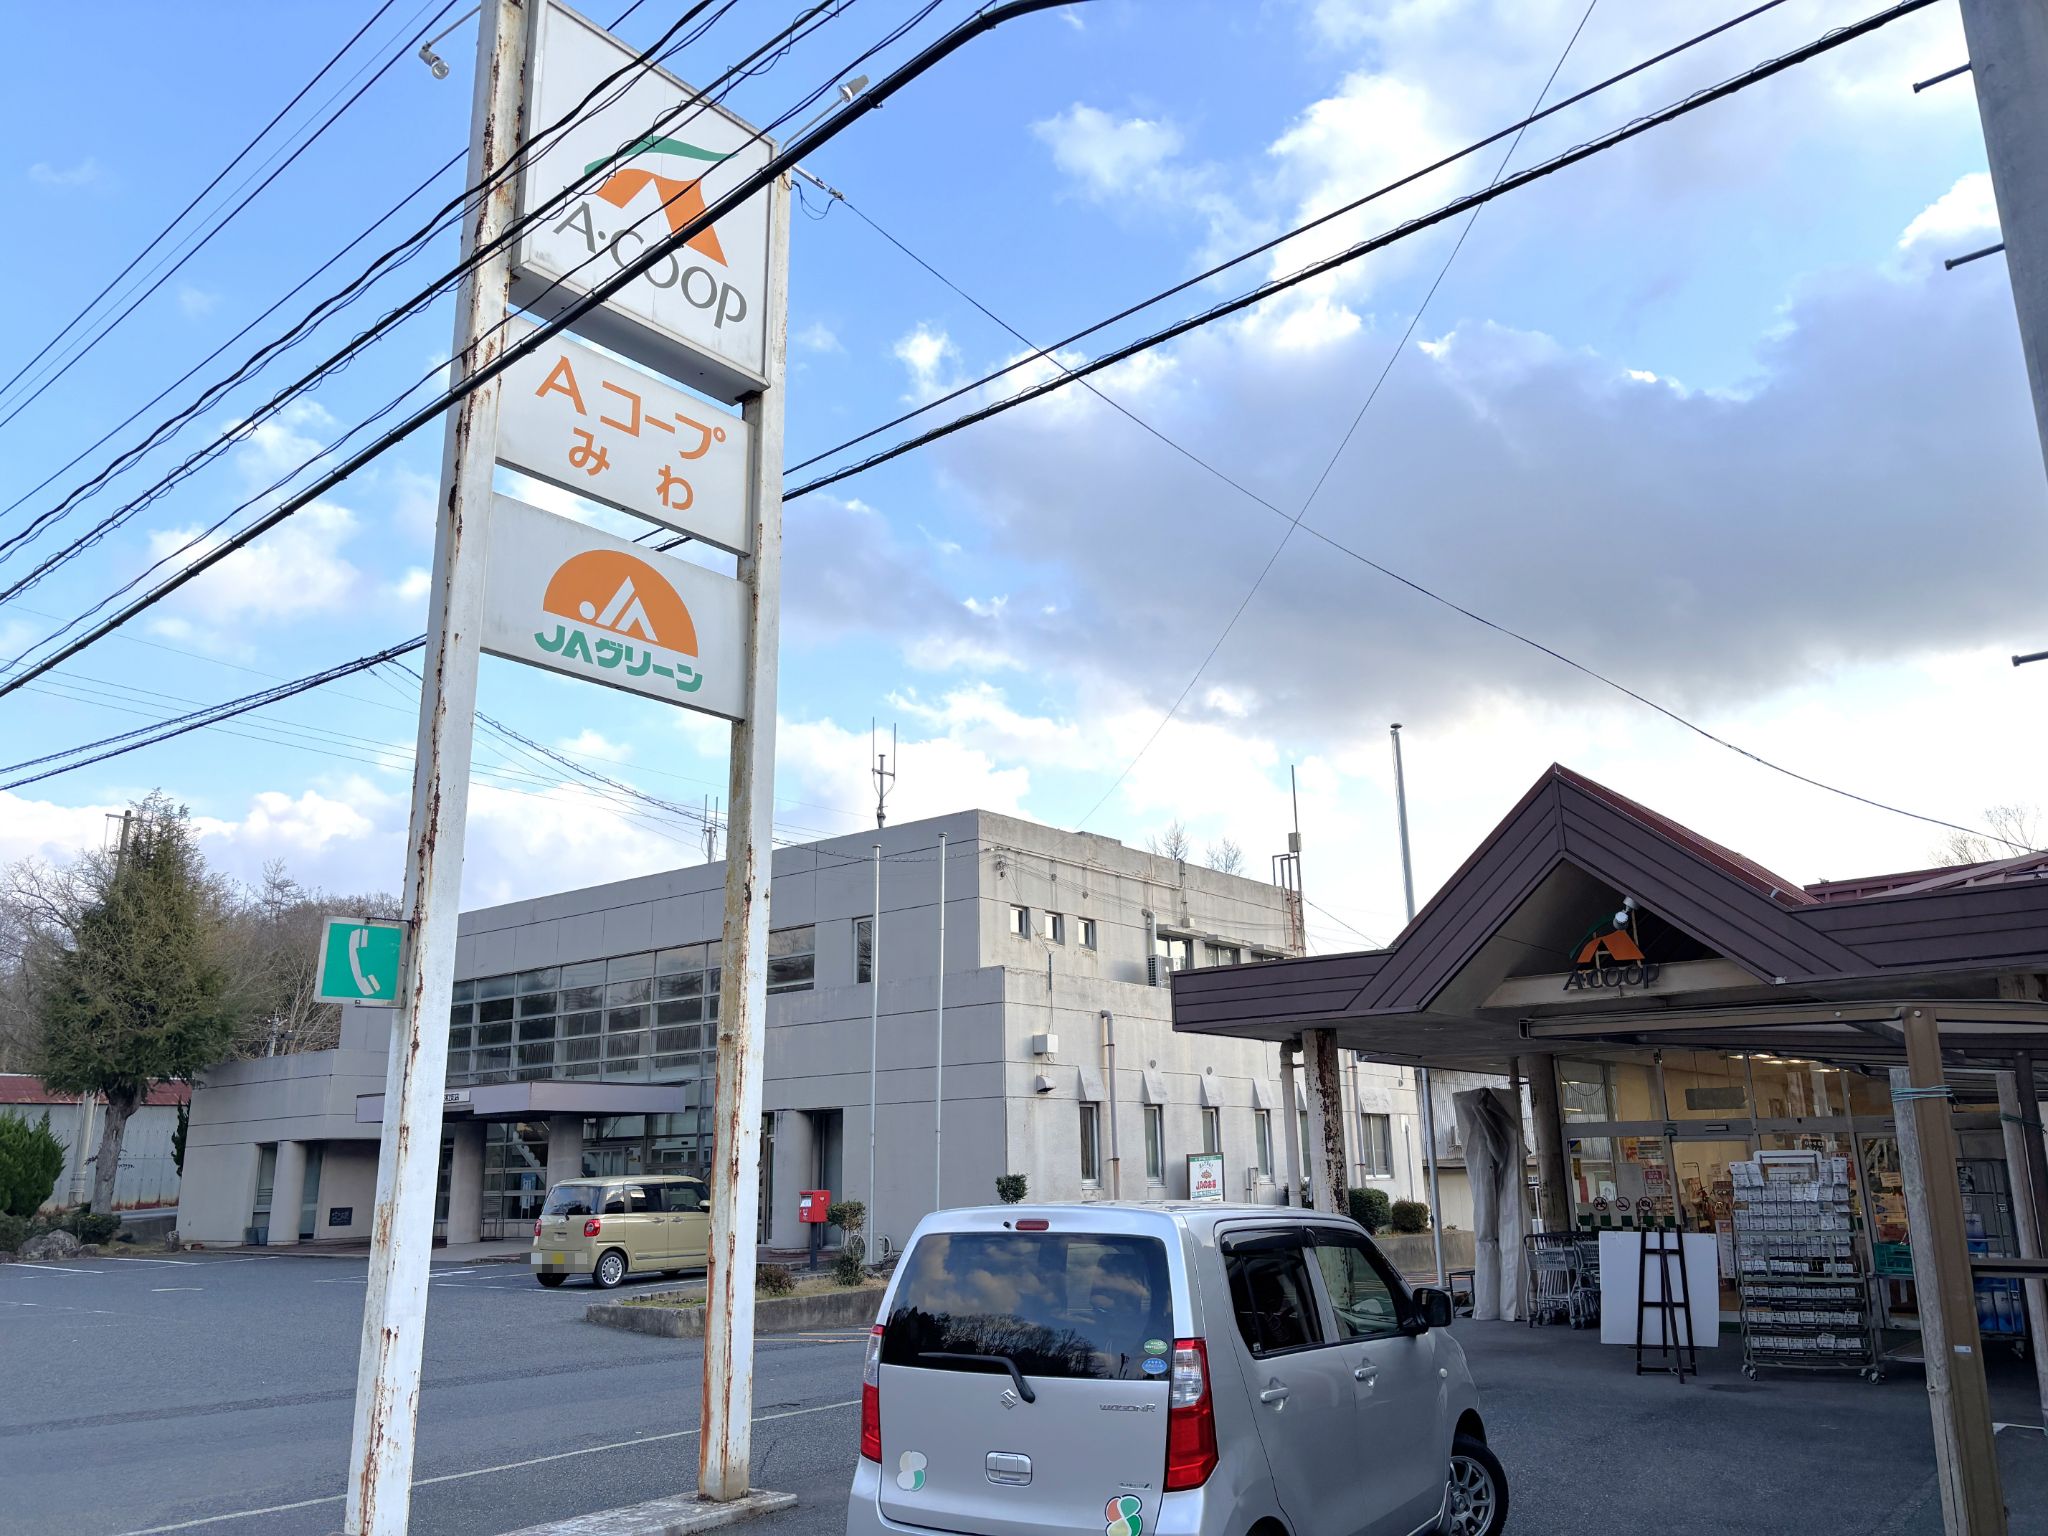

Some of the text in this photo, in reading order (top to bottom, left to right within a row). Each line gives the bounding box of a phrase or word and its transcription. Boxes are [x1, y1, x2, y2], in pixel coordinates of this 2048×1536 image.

[535, 354, 727, 460] Aコープ
[534, 624, 704, 693] JAグリーン
